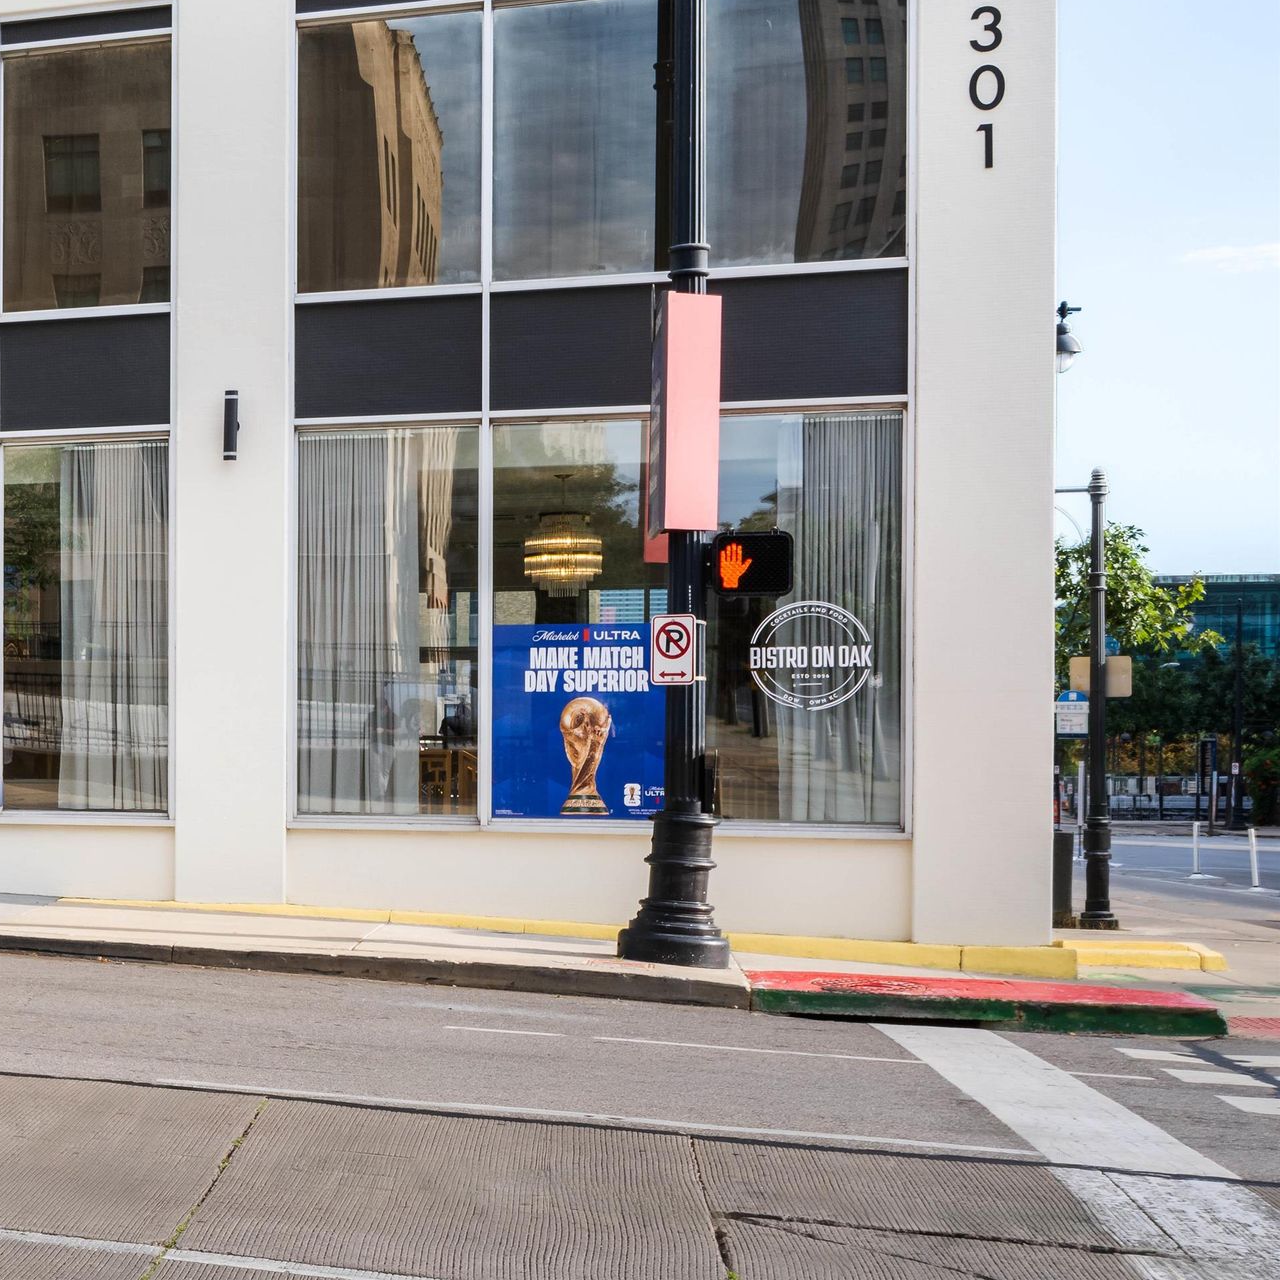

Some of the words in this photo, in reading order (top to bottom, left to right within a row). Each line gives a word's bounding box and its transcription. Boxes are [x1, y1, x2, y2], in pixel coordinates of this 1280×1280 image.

[770, 607, 808, 627] COCKTAILS
[828, 610, 849, 624] FOOD
[532, 630, 580, 642] Michelob
[593, 630, 641, 640] ULTRA
[529, 647, 578, 670] MAKE
[583, 646, 644, 669] MATCH
[749, 646, 808, 669] BISTRO
[811, 645, 835, 668] ON
[838, 644, 873, 667] OAK
[524, 670, 559, 692] DAY
[563, 670, 649, 692] SUPERIOR
